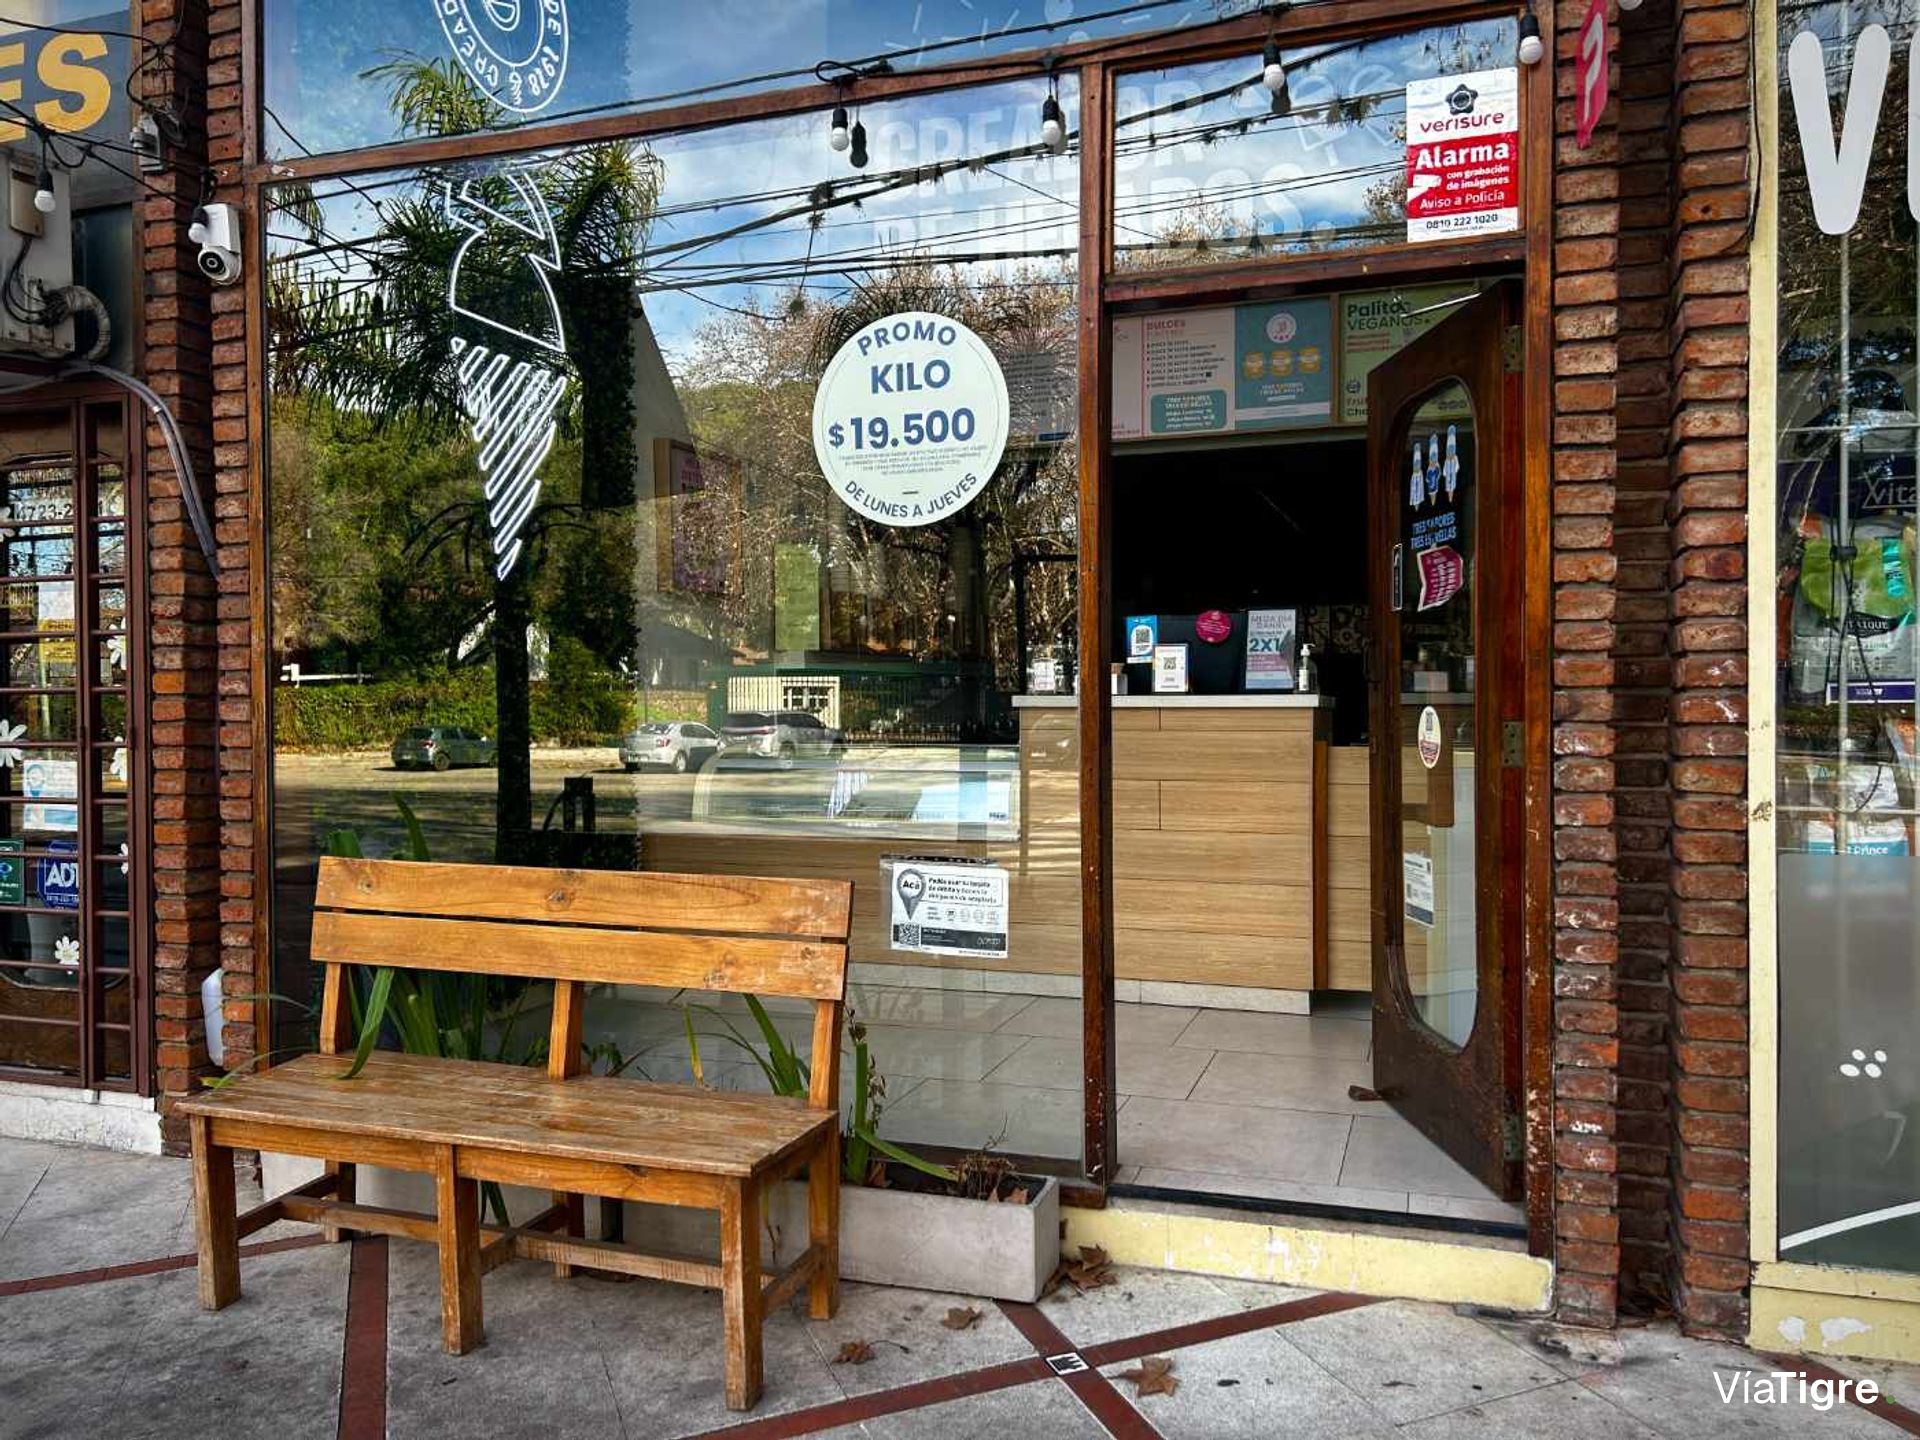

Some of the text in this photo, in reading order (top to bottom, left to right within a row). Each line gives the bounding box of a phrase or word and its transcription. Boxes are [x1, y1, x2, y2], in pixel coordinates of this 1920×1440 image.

[1420, 112, 1505, 133] verisure
[1416, 142, 1510, 170] Alarma
[1446, 164, 1510, 180] con grabación
[1446, 175, 1510, 191] de imágenes
[1420, 190, 1505, 210] Aviso a Policía
[1426, 213, 1498, 229] 0810 222 1020
[857, 320, 956, 357] PROMO
[871, 359, 951, 394] KILO
[828, 407, 976, 450] $19.500
[844, 472, 977, 518] DE LUNES A JUEVES
